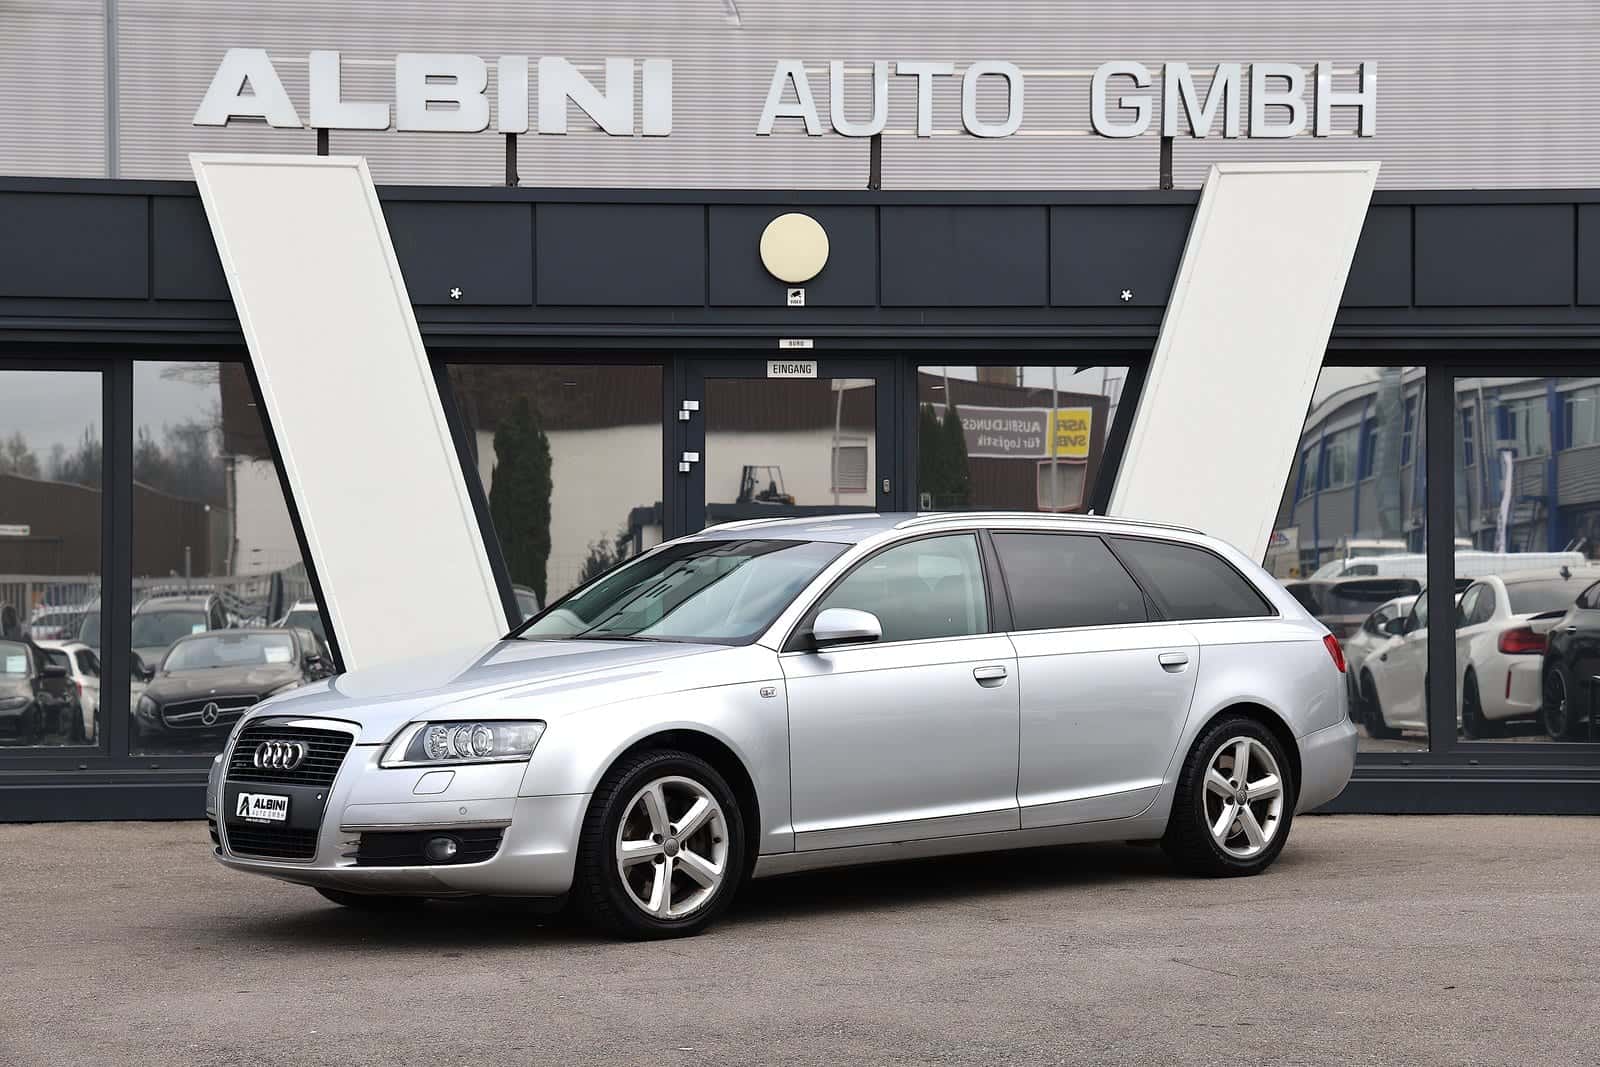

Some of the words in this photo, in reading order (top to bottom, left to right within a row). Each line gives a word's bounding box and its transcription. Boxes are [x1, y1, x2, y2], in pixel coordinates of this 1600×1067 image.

[192, 48, 673, 136] ALBINI
[755, 59, 1025, 137] AUTO
[1090, 60, 1379, 139] GMBH
[773, 364, 812, 374] EINGANG
[253, 798, 286, 811] ALBINI
